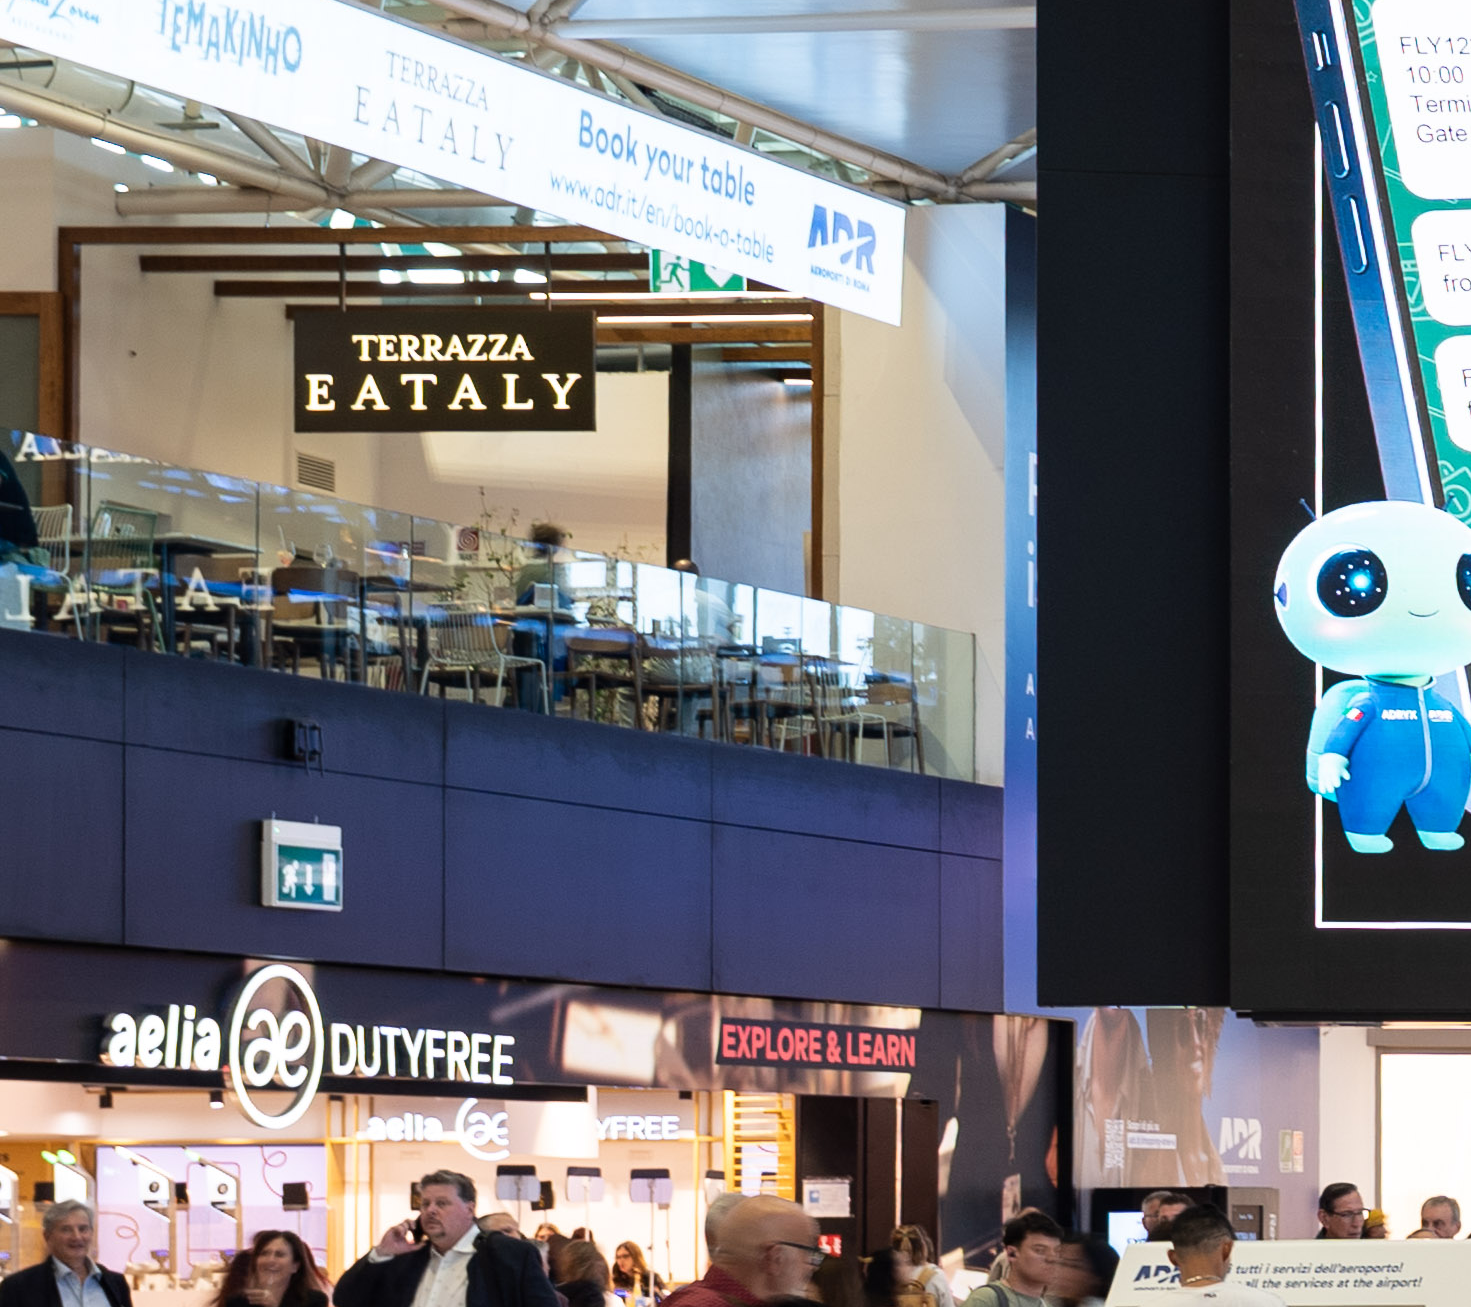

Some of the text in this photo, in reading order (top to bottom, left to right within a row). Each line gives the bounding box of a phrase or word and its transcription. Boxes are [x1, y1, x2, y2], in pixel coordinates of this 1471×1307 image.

[386, 50, 490, 112] TERRAZZA
[1406, 66, 1465, 86] 10:00
[353, 85, 515, 171] EATALY
[1416, 124, 1469, 145] Gate
[579, 109, 756, 207] Book your table
[808, 203, 877, 277] ADR
[351, 333, 535, 362] TERRAZZA
[305, 371, 584, 412] EATALY
[106, 1004, 516, 1087] aelia DUTYFREE
[722, 1021, 917, 1069] EXPLORE & LEARN
[366, 1112, 444, 1142] aelia
[1219, 1117, 1262, 1160] ADR
